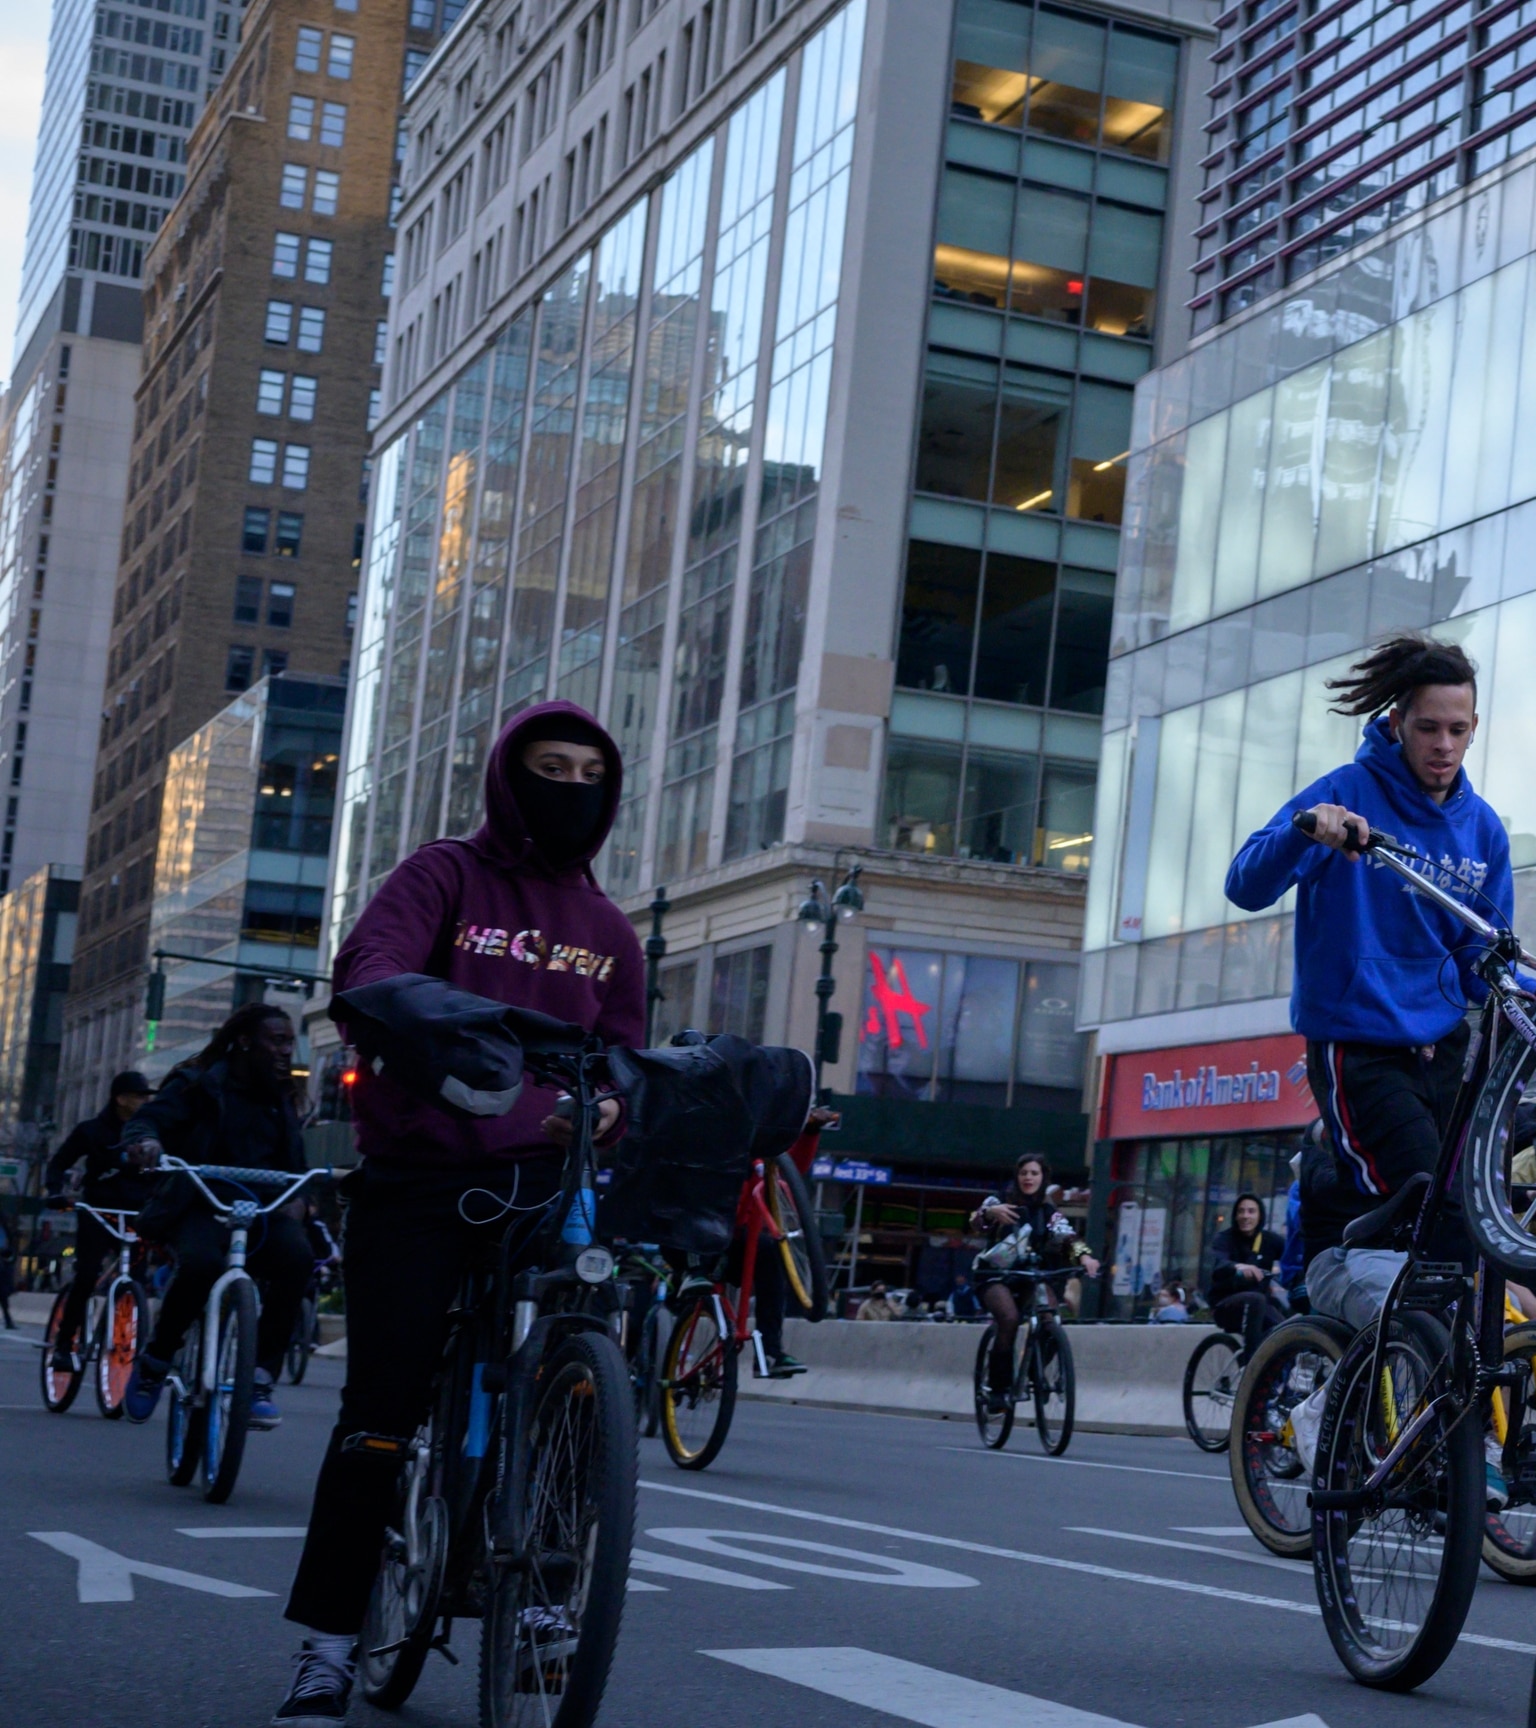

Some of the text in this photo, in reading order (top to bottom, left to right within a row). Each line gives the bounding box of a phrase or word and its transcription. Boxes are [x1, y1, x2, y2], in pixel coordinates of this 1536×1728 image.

[1142, 1061, 1281, 1111] Bank of America
